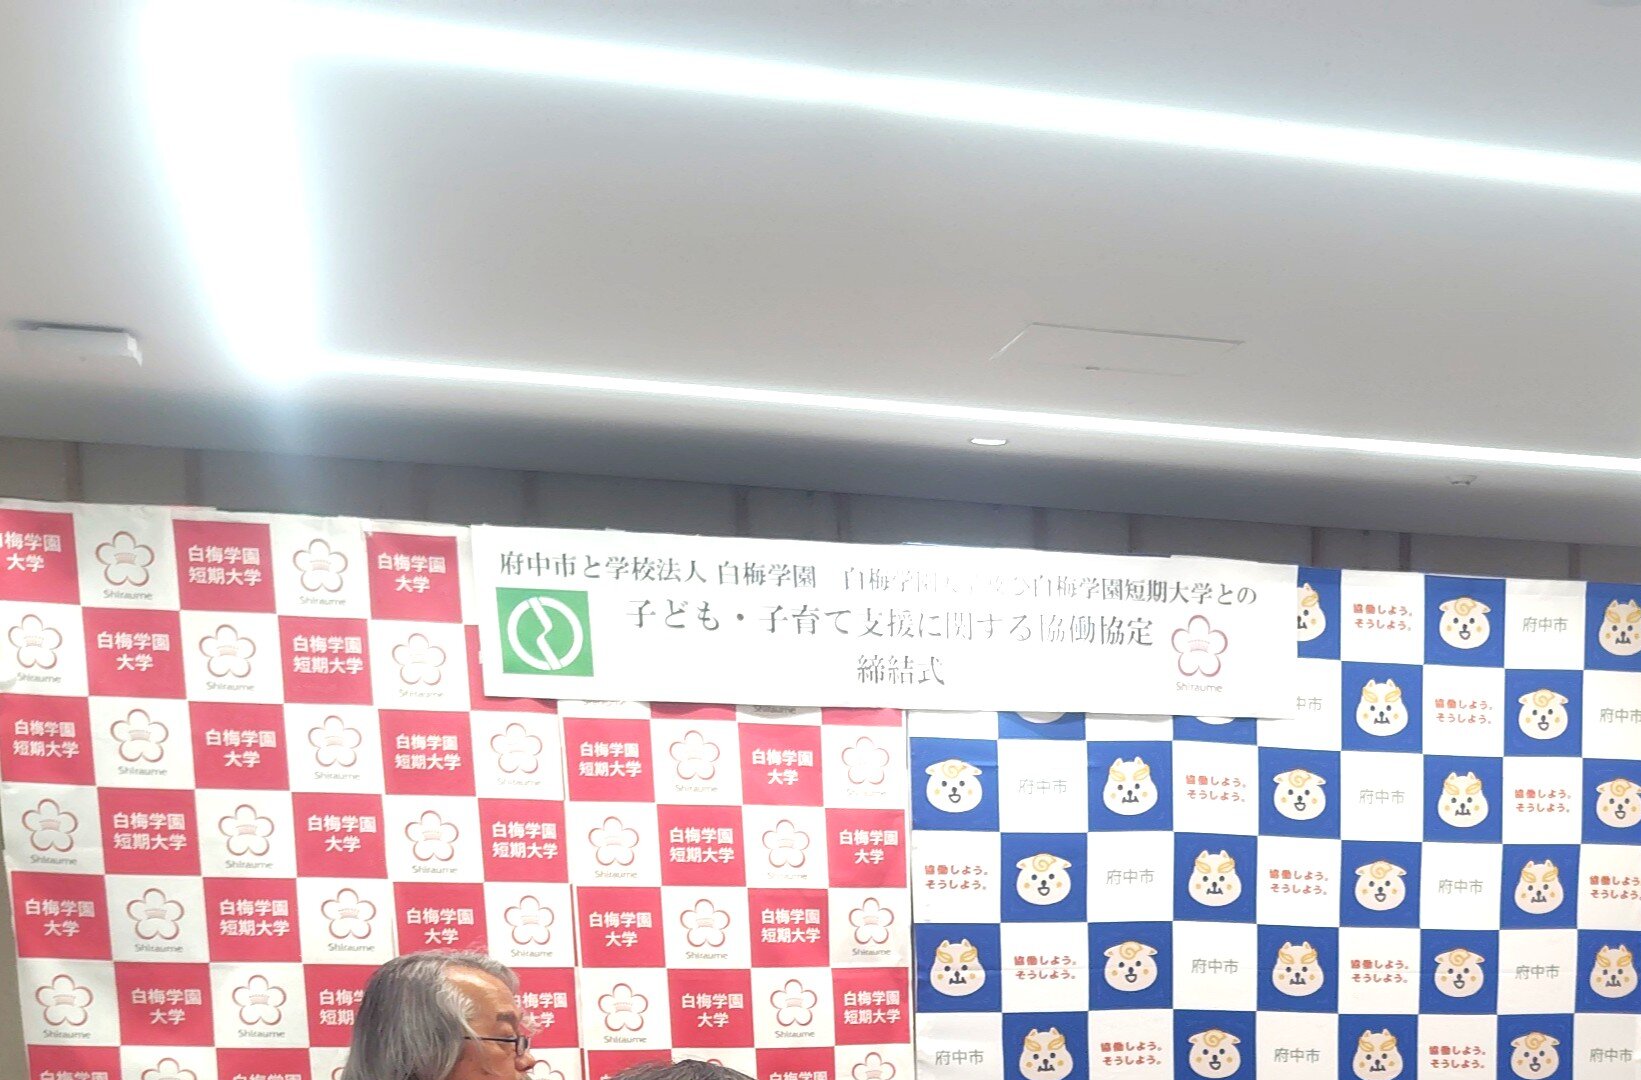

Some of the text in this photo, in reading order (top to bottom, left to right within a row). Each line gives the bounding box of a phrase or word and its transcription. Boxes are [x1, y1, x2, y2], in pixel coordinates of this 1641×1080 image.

[7, 553, 44, 572] 大学
[189, 545, 260, 565] 白梅学園
[378, 553, 446, 573] 白梅学園
[501, 551, 706, 583] 府中市と学校法人
[719, 561, 815, 588] 白梅学園
[189, 567, 261, 586] 短期大学
[396, 575, 429, 593] 大学
[104, 590, 152, 600] Shiraume
[299, 596, 346, 605] Shiraume
[1353, 604, 1412, 616] 協働しよう。
[626, 599, 1153, 646] 子ども・子育て支援に関する協働協定
[1355, 619, 1411, 631] そうしよう。
[1523, 617, 1568, 632] 府中市
[98, 631, 169, 651] 白梅学園
[293, 635, 362, 654] 白梅学園
[117, 654, 153, 671] 大学
[294, 656, 363, 674] 短期大学
[857, 655, 944, 685] 締結式
[206, 681, 254, 691] Shiraume
[1176, 682, 1222, 692] Shiraume
[1435, 699, 1492, 710] 協働しよう。
[1436, 713, 1491, 724] そうしよう。
[15, 719, 75, 737] 白梅学園
[206, 729, 276, 747] 白梅学園
[397, 734, 458, 750] 白梅学園
[13, 740, 79, 758] 短期大学
[581, 742, 639, 758] 白梅学園
[225, 751, 260, 767] 大学
[395, 753, 461, 770] 短期大学
[752, 749, 813, 766] 白梅学園
[118, 766, 167, 775] Shiraume
[579, 761, 641, 777] 短期大学
[768, 769, 798, 785] 大学
[1186, 775, 1245, 787] 協働しよう。
[1019, 779, 1067, 794] 府中市
[1515, 789, 1571, 798] 協働しよう。
[1187, 790, 1244, 802] そうしよう。
[1360, 789, 1404, 804] 府中市
[1516, 803, 1569, 812] そうしよう。
[114, 813, 185, 830] 白梅学園
[308, 815, 376, 833] 白梅学園
[493, 822, 556, 839] 白梅学園
[670, 827, 733, 844] 白梅学園
[840, 830, 898, 845] 白梅学園
[114, 833, 186, 850] 短期大学
[326, 835, 360, 852] 大学
[493, 842, 558, 859] 短期大学
[670, 847, 734, 863] 短期大学
[855, 849, 883, 864] 大学
[30, 855, 77, 865] Shiraume
[225, 860, 273, 869] Shiraume
[412, 865, 457, 873] Shiraume
[925, 865, 987, 875] 協働しよう。
[1269, 869, 1328, 881] 協働しよう。
[1106, 869, 1154, 885] 府中市
[926, 880, 986, 890] そうしよう。
[1271, 884, 1327, 895] そうしよう。
[1439, 879, 1483, 894] 府中市
[1590, 890, 1641, 900] そうしよう。
[25, 899, 94, 917] 白梅学園
[220, 900, 288, 916] 白梅学園
[407, 908, 474, 924] 白梅学園
[590, 912, 652, 928] 白梅学園
[762, 908, 820, 924] 白梅学園
[44, 920, 79, 936] 大学
[220, 920, 289, 936] 短期大学
[762, 928, 820, 943] 短期大学
[606, 931, 637, 947] 大学
[135, 944, 183, 953] Shiraume
[328, 943, 375, 951] Shiraume
[511, 949, 553, 957] Shiraume
[852, 948, 891, 956] Shiraume
[685, 951, 728, 959] Shiraume
[1014, 956, 1076, 965] 協働しよう。
[1192, 959, 1238, 974] 府中市
[1351, 960, 1408, 969] 協働しよう。
[1515, 964, 1559, 979] 府中市
[1016, 969, 1075, 980] そうしよう。
[1352, 974, 1407, 983] そうしよう。
[132, 989, 201, 1005] 白梅学園
[682, 993, 743, 1009] 白梅学園
[844, 991, 899, 1006] 白梅学園
[151, 1009, 185, 1024] 大学
[698, 1012, 728, 1027] 大学
[844, 1009, 900, 1024] 短期大学
[43, 1030, 91, 1038] Shiraume
[238, 1029, 285, 1037] Shiraume
[1101, 1042, 1161, 1052] 協働しよう。
[1429, 1046, 1485, 1055] 協働しよう。
[936, 1049, 983, 1065] 府中市
[1103, 1055, 1161, 1066] そうしよう。
[1274, 1048, 1320, 1063] 府中市
[1590, 1048, 1632, 1062] 府中市
[1431, 1059, 1484, 1068] そうしよう。
